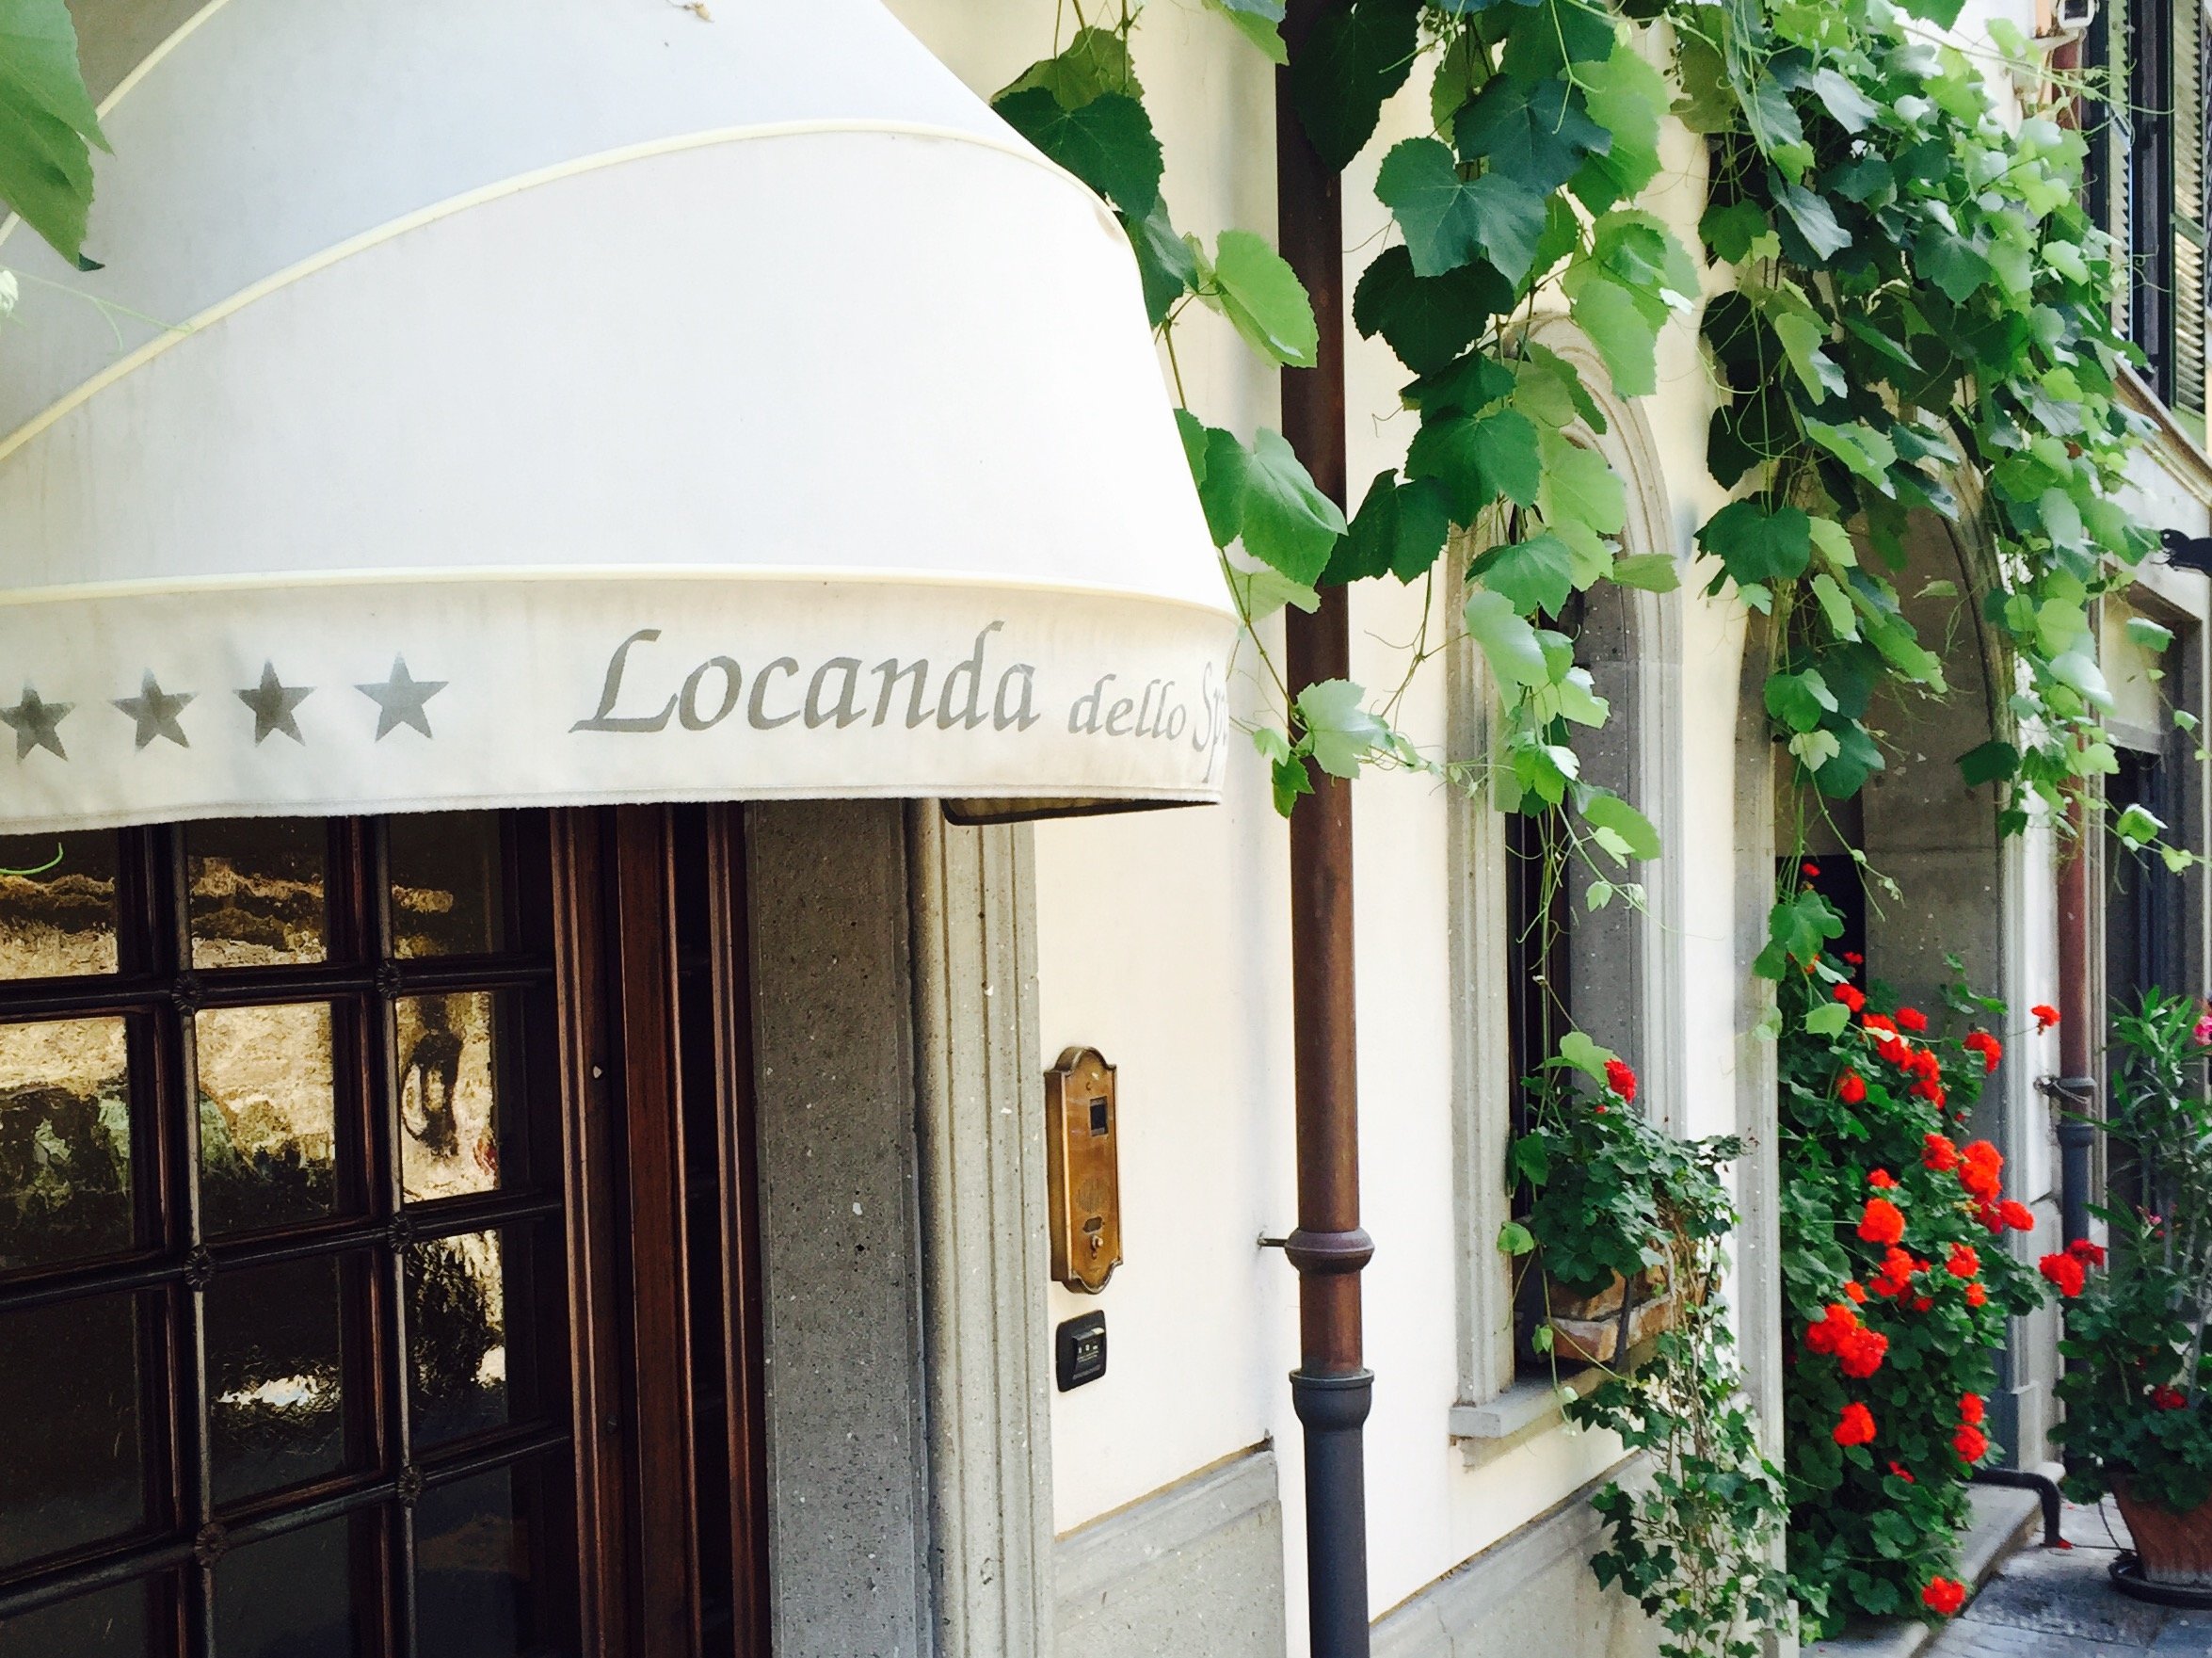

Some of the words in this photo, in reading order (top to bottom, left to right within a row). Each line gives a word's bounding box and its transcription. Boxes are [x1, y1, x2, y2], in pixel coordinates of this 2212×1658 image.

[569, 620, 1040, 733] Locanda
[1067, 673, 1186, 741] dello
[1192, 661, 1226, 784] Sp
